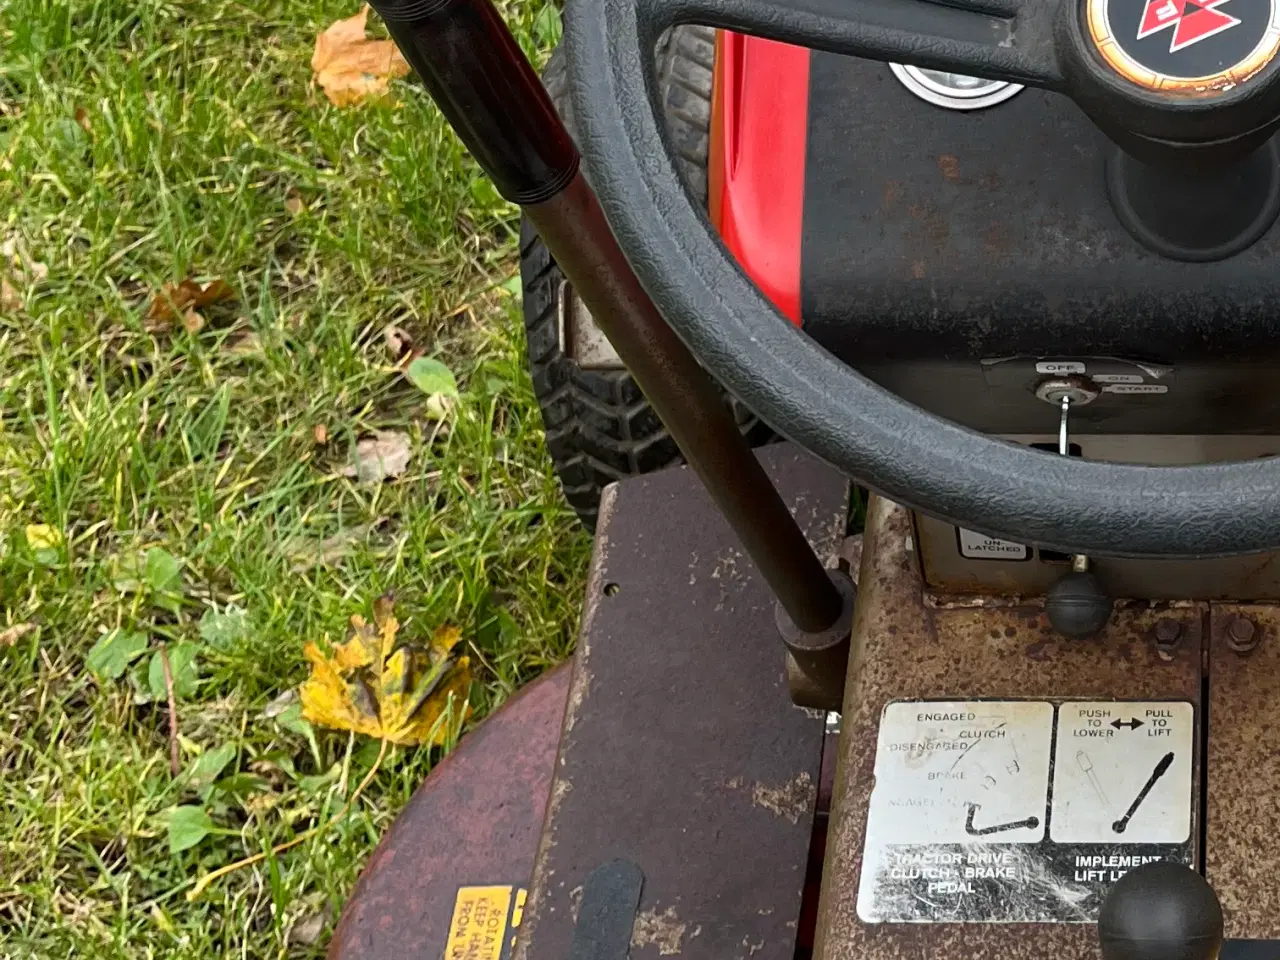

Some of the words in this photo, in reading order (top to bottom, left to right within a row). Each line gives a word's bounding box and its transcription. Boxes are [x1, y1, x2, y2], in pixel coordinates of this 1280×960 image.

[916, 713, 976, 722] ENGAGED
[1078, 709, 1112, 718] PUSH
[1145, 709, 1173, 718] PULL
[1087, 719, 1102, 727] TO
[1151, 719, 1168, 727] TO
[958, 729, 1006, 739] CLUTCH
[1073, 729, 1115, 738] LOWER
[1147, 728, 1172, 737] LIFT
[889, 742, 968, 752] DISENGAGED
[894, 853, 963, 865] TRACTOR
[967, 852, 1013, 864] DRIVE
[891, 867, 950, 879] CLUTCH
[964, 867, 1016, 879] BRAKE
[1074, 870, 1106, 882] LIFT
[928, 882, 976, 894] PEDAL
[474, 897, 488, 928] KEEP
[456, 900, 474, 938] FROM
